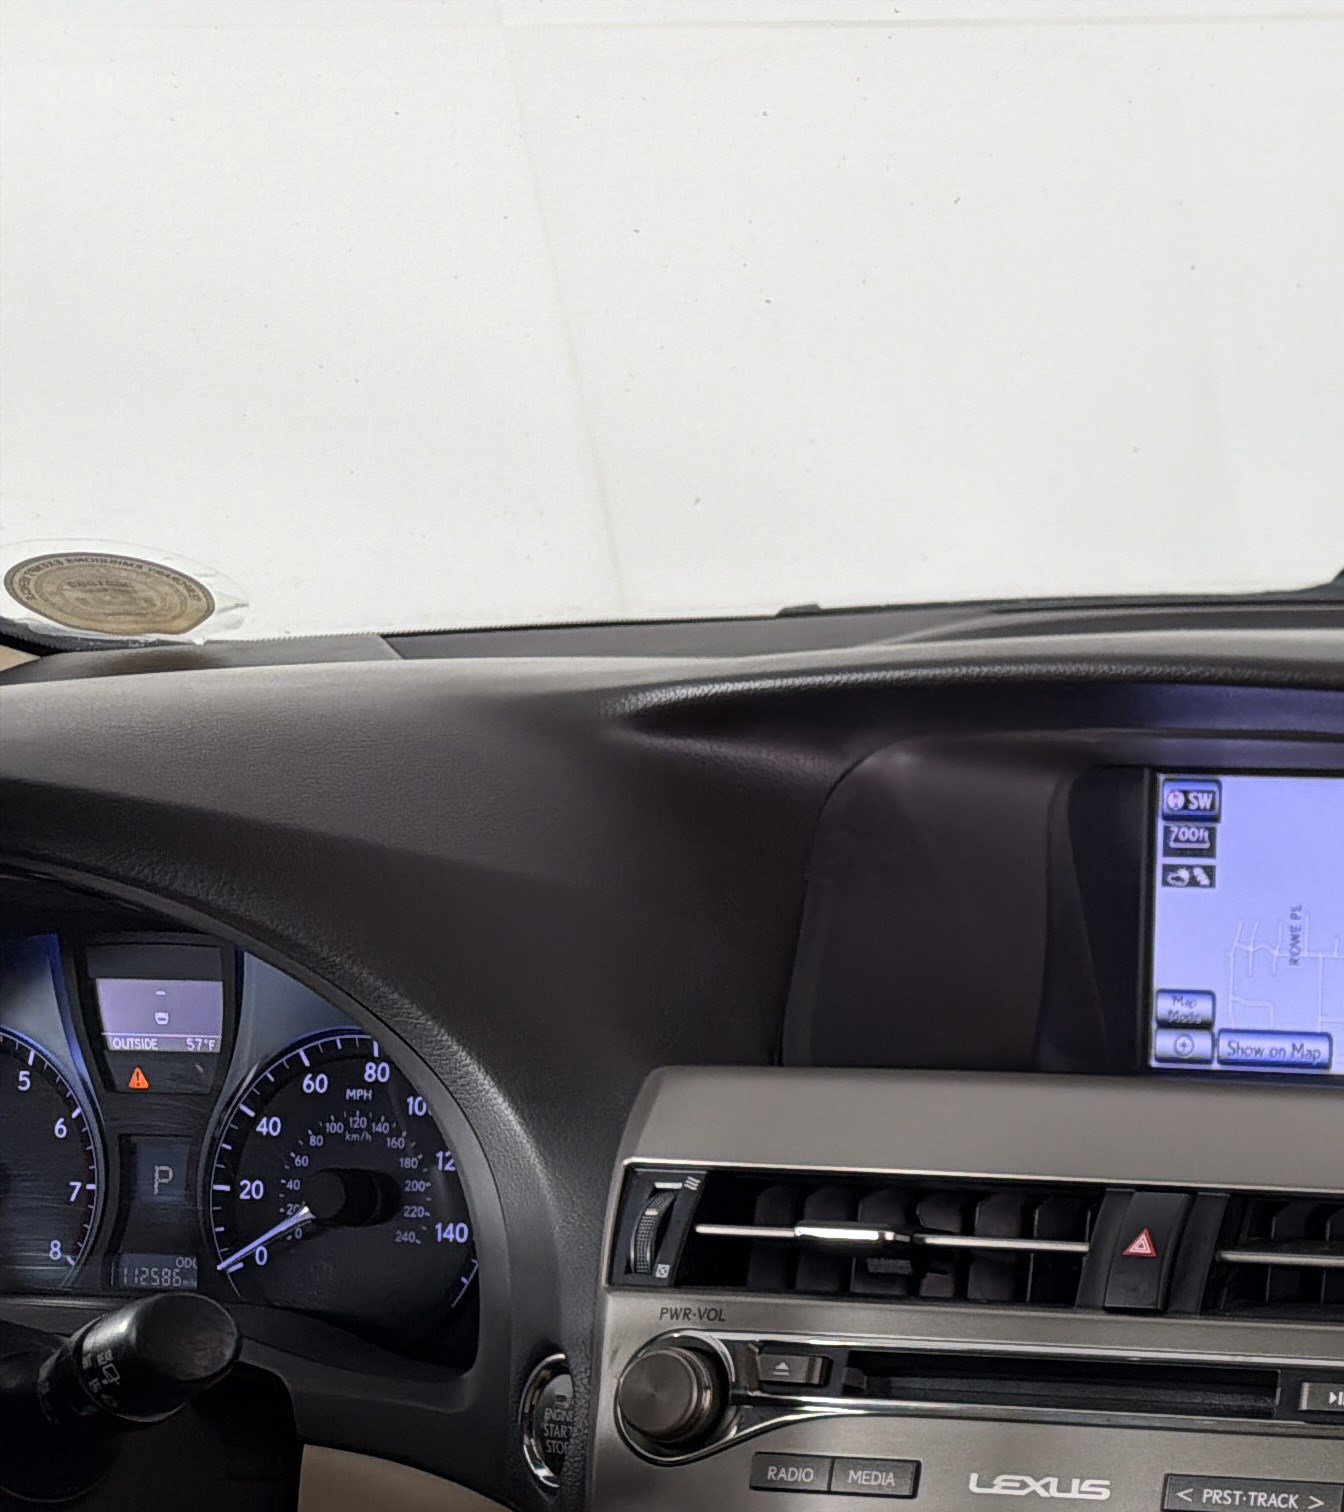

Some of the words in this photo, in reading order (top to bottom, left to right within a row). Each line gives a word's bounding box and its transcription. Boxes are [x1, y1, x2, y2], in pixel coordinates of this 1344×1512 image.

[1187, 791, 1214, 811] SW
[112, 1037, 159, 1051] OUTSIDE
[1226, 1040, 1264, 1058] Show
[1268, 1046, 1287, 1058] on
[1291, 1042, 1322, 1062] Map
[17, 1071, 31, 1092] 5
[364, 1062, 390, 1083] 80
[302, 1073, 328, 1094] 60
[345, 1089, 373, 1101] MPH
[406, 1096, 433, 1117] 10
[54, 1118, 68, 1139] 6
[256, 1116, 282, 1137] 40
[325, 1121, 344, 1134] 100
[349, 1116, 367, 1129] 120
[372, 1122, 389, 1135] 140
[309, 1134, 324, 1147] 80
[344, 1130, 373, 1142] km/h
[386, 1136, 406, 1149] 160
[294, 1155, 309, 1168] 60
[400, 1156, 419, 1169] 180
[435, 1150, 456, 1172] 12
[154, 1165, 174, 1195] P
[238, 1179, 264, 1200] 20
[286, 1178, 300, 1191] 40
[404, 1180, 426, 1193] 200
[69, 1182, 82, 1203] 7
[403, 1206, 425, 1218] 220
[395, 1230, 416, 1243] 240
[434, 1222, 469, 1244] 140
[49, 1241, 63, 1261] 8
[253, 1246, 268, 1267] 0
[121, 1267, 182, 1288] 112586
[767, 1465, 815, 1484] RADIO
[847, 1469, 896, 1488] MEDIA
[968, 1472, 1111, 1501] LEXUS
